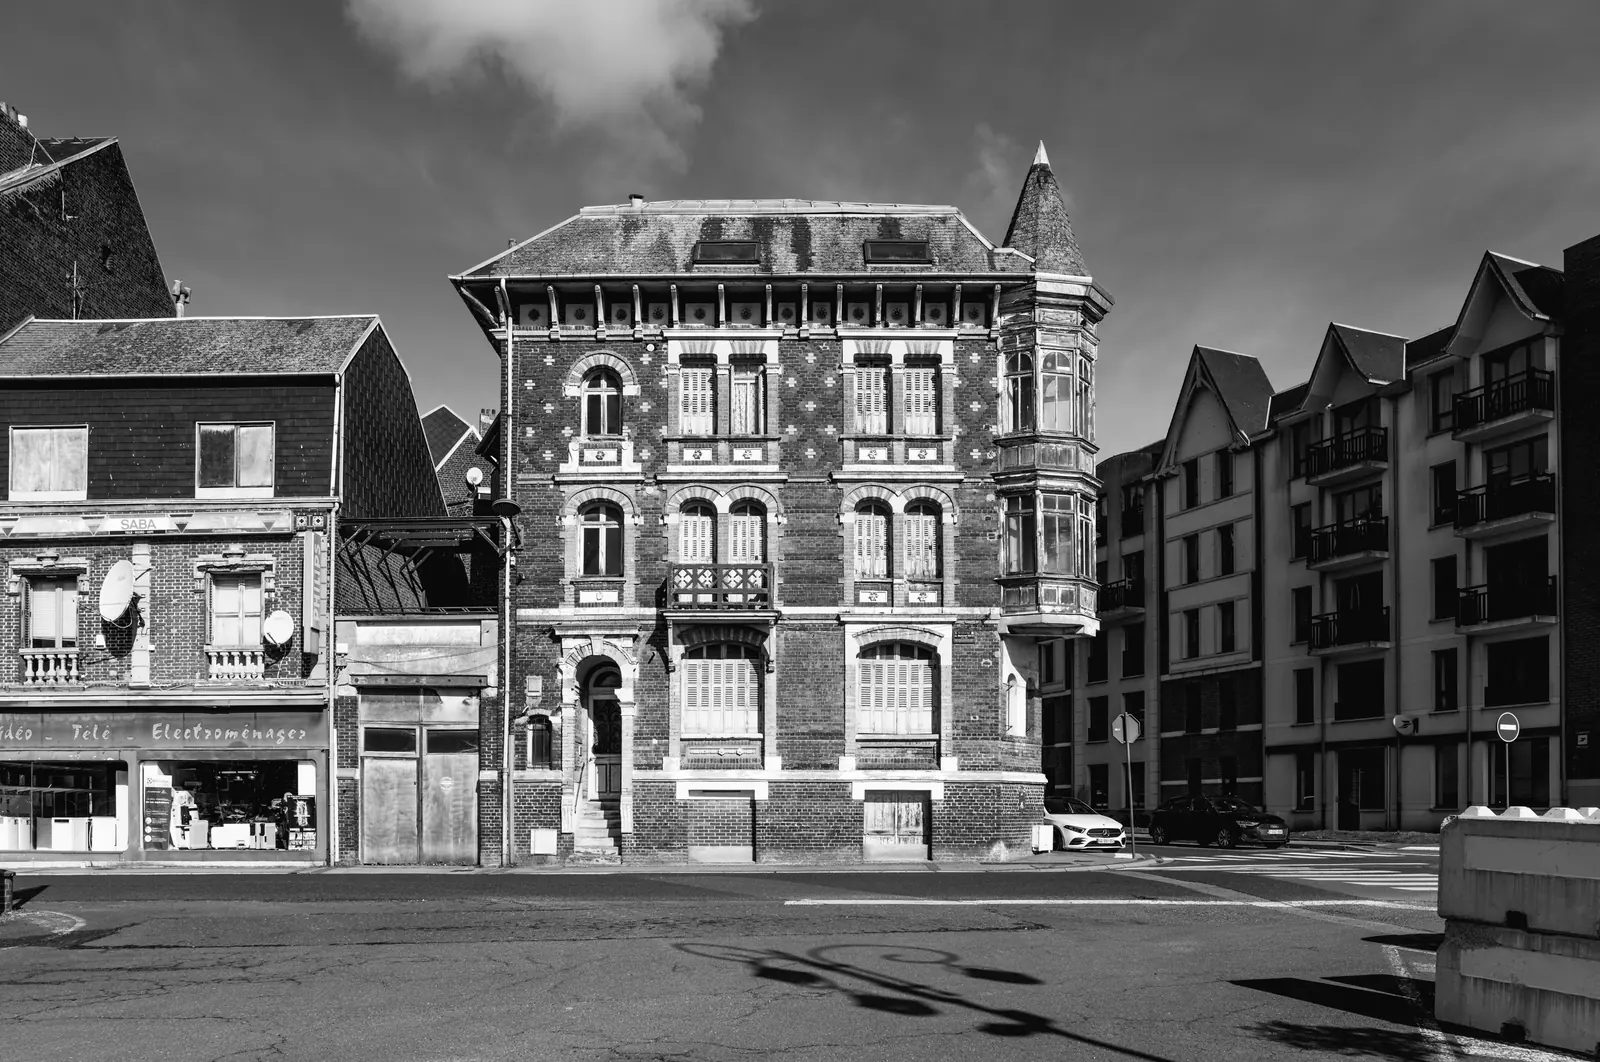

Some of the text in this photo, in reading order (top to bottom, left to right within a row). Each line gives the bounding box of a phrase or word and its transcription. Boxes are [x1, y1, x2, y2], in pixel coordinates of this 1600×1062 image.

[121, 519, 157, 530] SABA
[313, 543, 321, 622] PHILIPS
[72, 724, 110, 740] Télé
[152, 723, 306, 744] Electroménager
